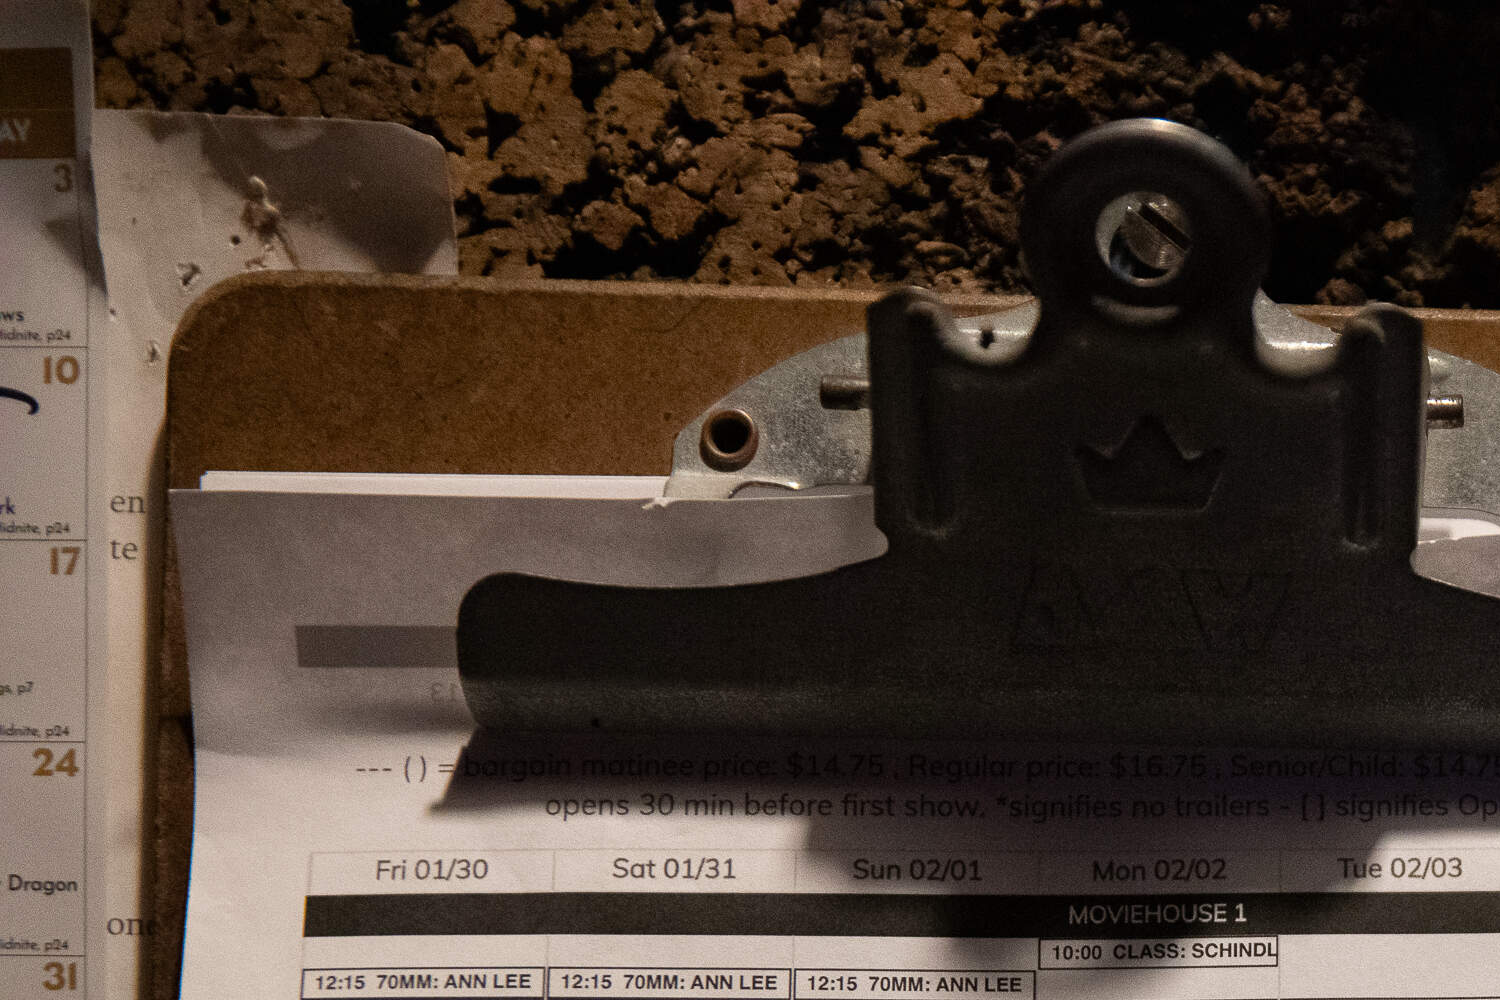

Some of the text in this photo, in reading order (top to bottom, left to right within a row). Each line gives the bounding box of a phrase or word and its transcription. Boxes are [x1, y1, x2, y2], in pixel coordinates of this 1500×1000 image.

[54, 165, 72, 193] 3
[44, 357, 80, 384] 10
[51, 547, 80, 575] 17
[33, 749, 79, 776] 24
[546, 798, 628, 819] opens
[640, 793, 674, 816] 30
[684, 793, 733, 815] min
[745, 793, 832, 816] before
[844, 793, 894, 816] first
[1132, 797, 1165, 816] no
[1174, 796, 1269, 816] trailers
[1336, 795, 1448, 822] signifies
[376, 859, 488, 880] Fri 01/30
[613, 858, 735, 880] Sat 01/31
[853, 859, 981, 881] Sun 02/01
[1093, 858, 1226, 881] Mon 02/02
[1338, 857, 1462, 879] Tue 02/03
[8, 874, 78, 896] Dragon
[1069, 904, 1247, 924] MOVIEHOUSE 1
[1052, 942, 1277, 961] 10:00 CLASS: SCHINDL
[43, 963, 76, 990] 31
[317, 974, 531, 990] 12:15 70MM: ANN LEE
